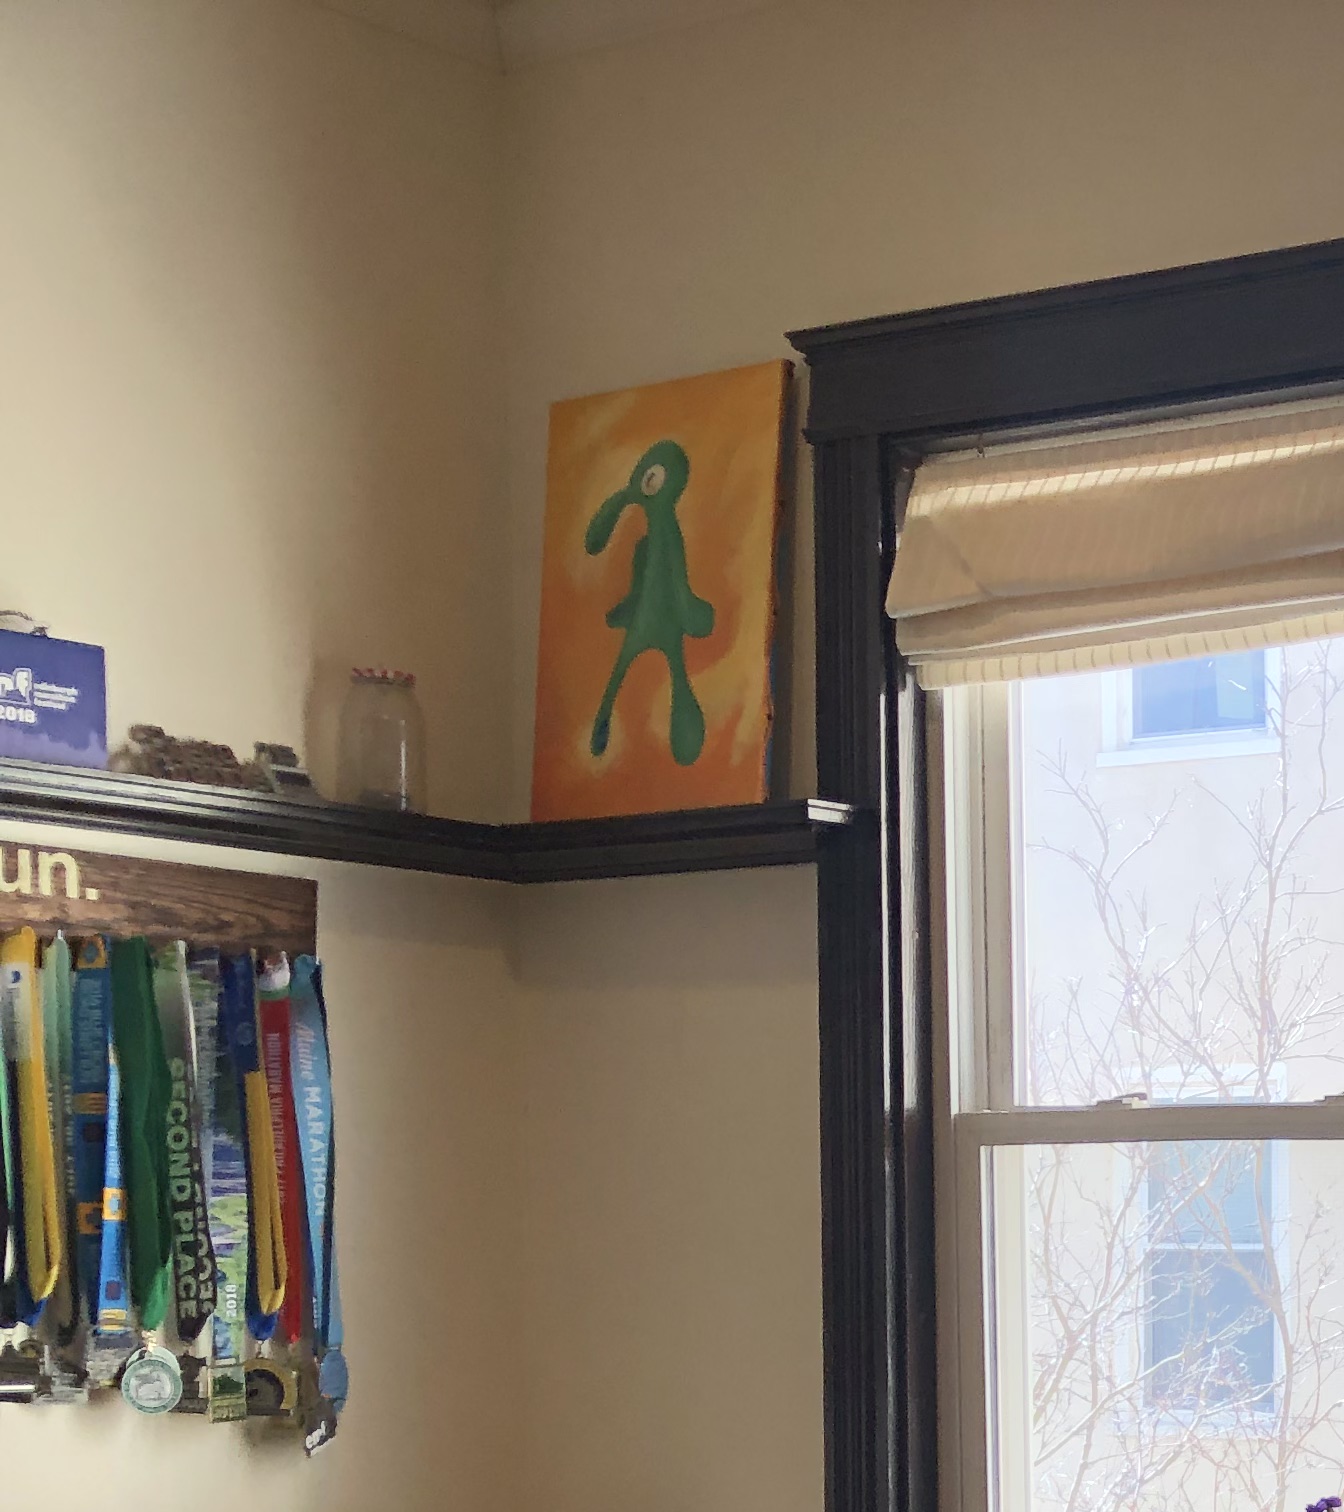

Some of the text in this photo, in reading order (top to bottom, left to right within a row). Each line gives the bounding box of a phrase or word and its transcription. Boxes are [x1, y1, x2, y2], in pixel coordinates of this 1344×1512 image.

[296, 1022, 328, 1216] Maine MARATHON
[173, 1210, 198, 1320] PLACE
[225, 1283, 237, 1318] 2018
